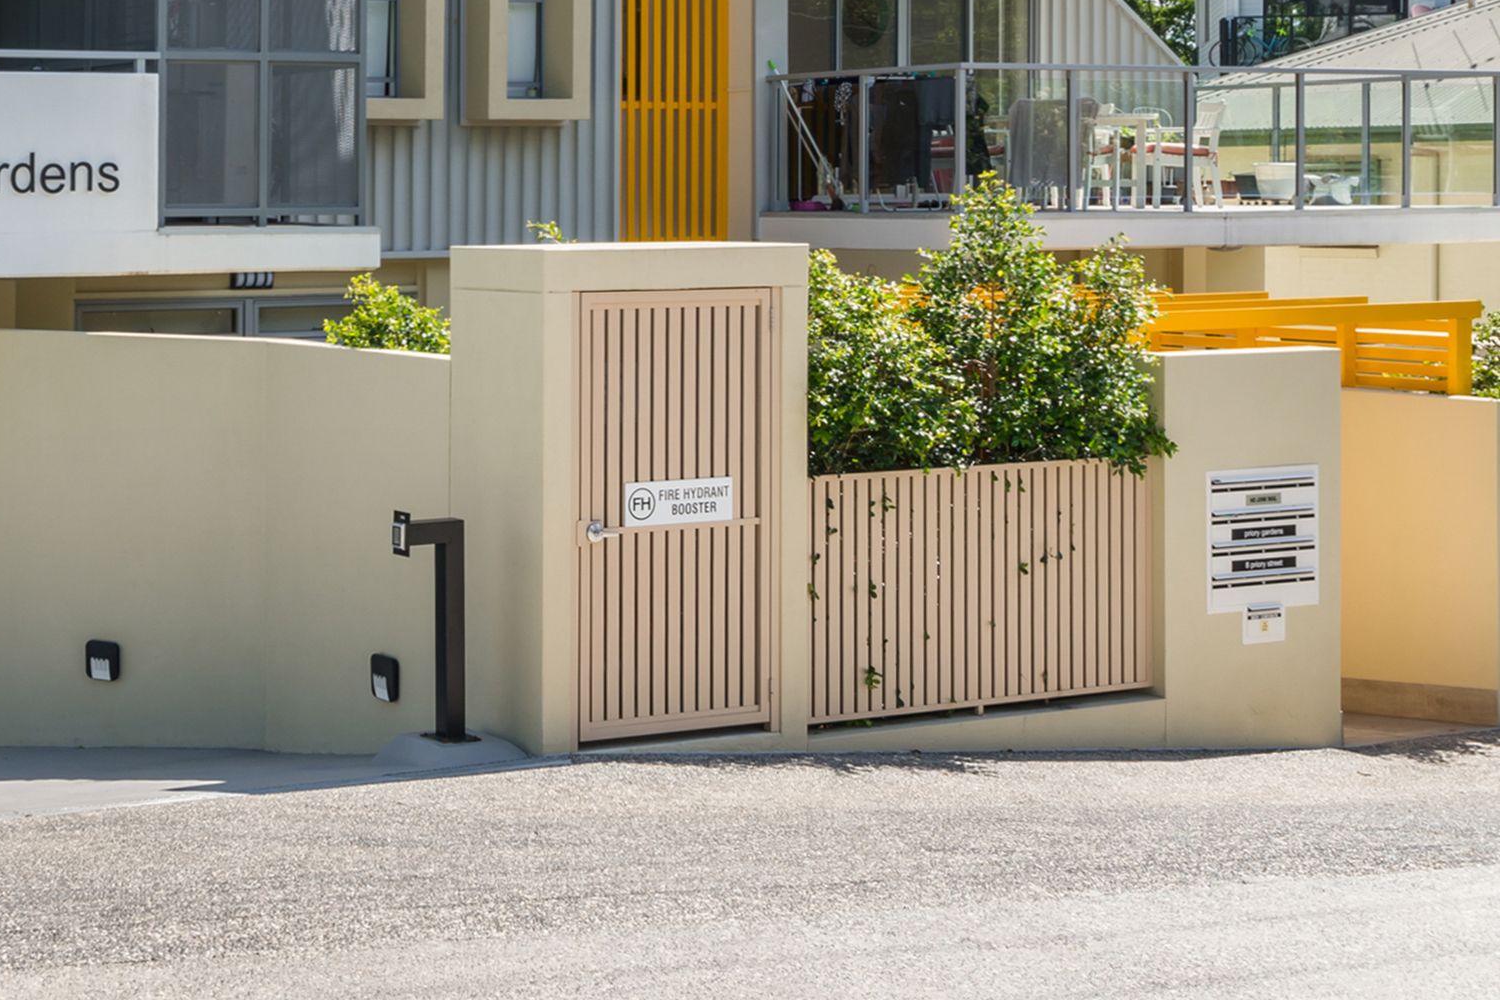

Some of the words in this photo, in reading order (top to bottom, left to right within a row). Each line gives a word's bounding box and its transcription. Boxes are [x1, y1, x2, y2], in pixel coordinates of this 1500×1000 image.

[658, 488, 680, 501] FIRE
[683, 485, 729, 499] HYDRANT
[632, 497, 651, 512] FH
[671, 501, 717, 515] BOOSTER
[1244, 530, 1260, 538] priory
[1261, 527, 1284, 537] gardens
[1250, 560, 1266, 569] priory
[1267, 559, 1284, 567] street
